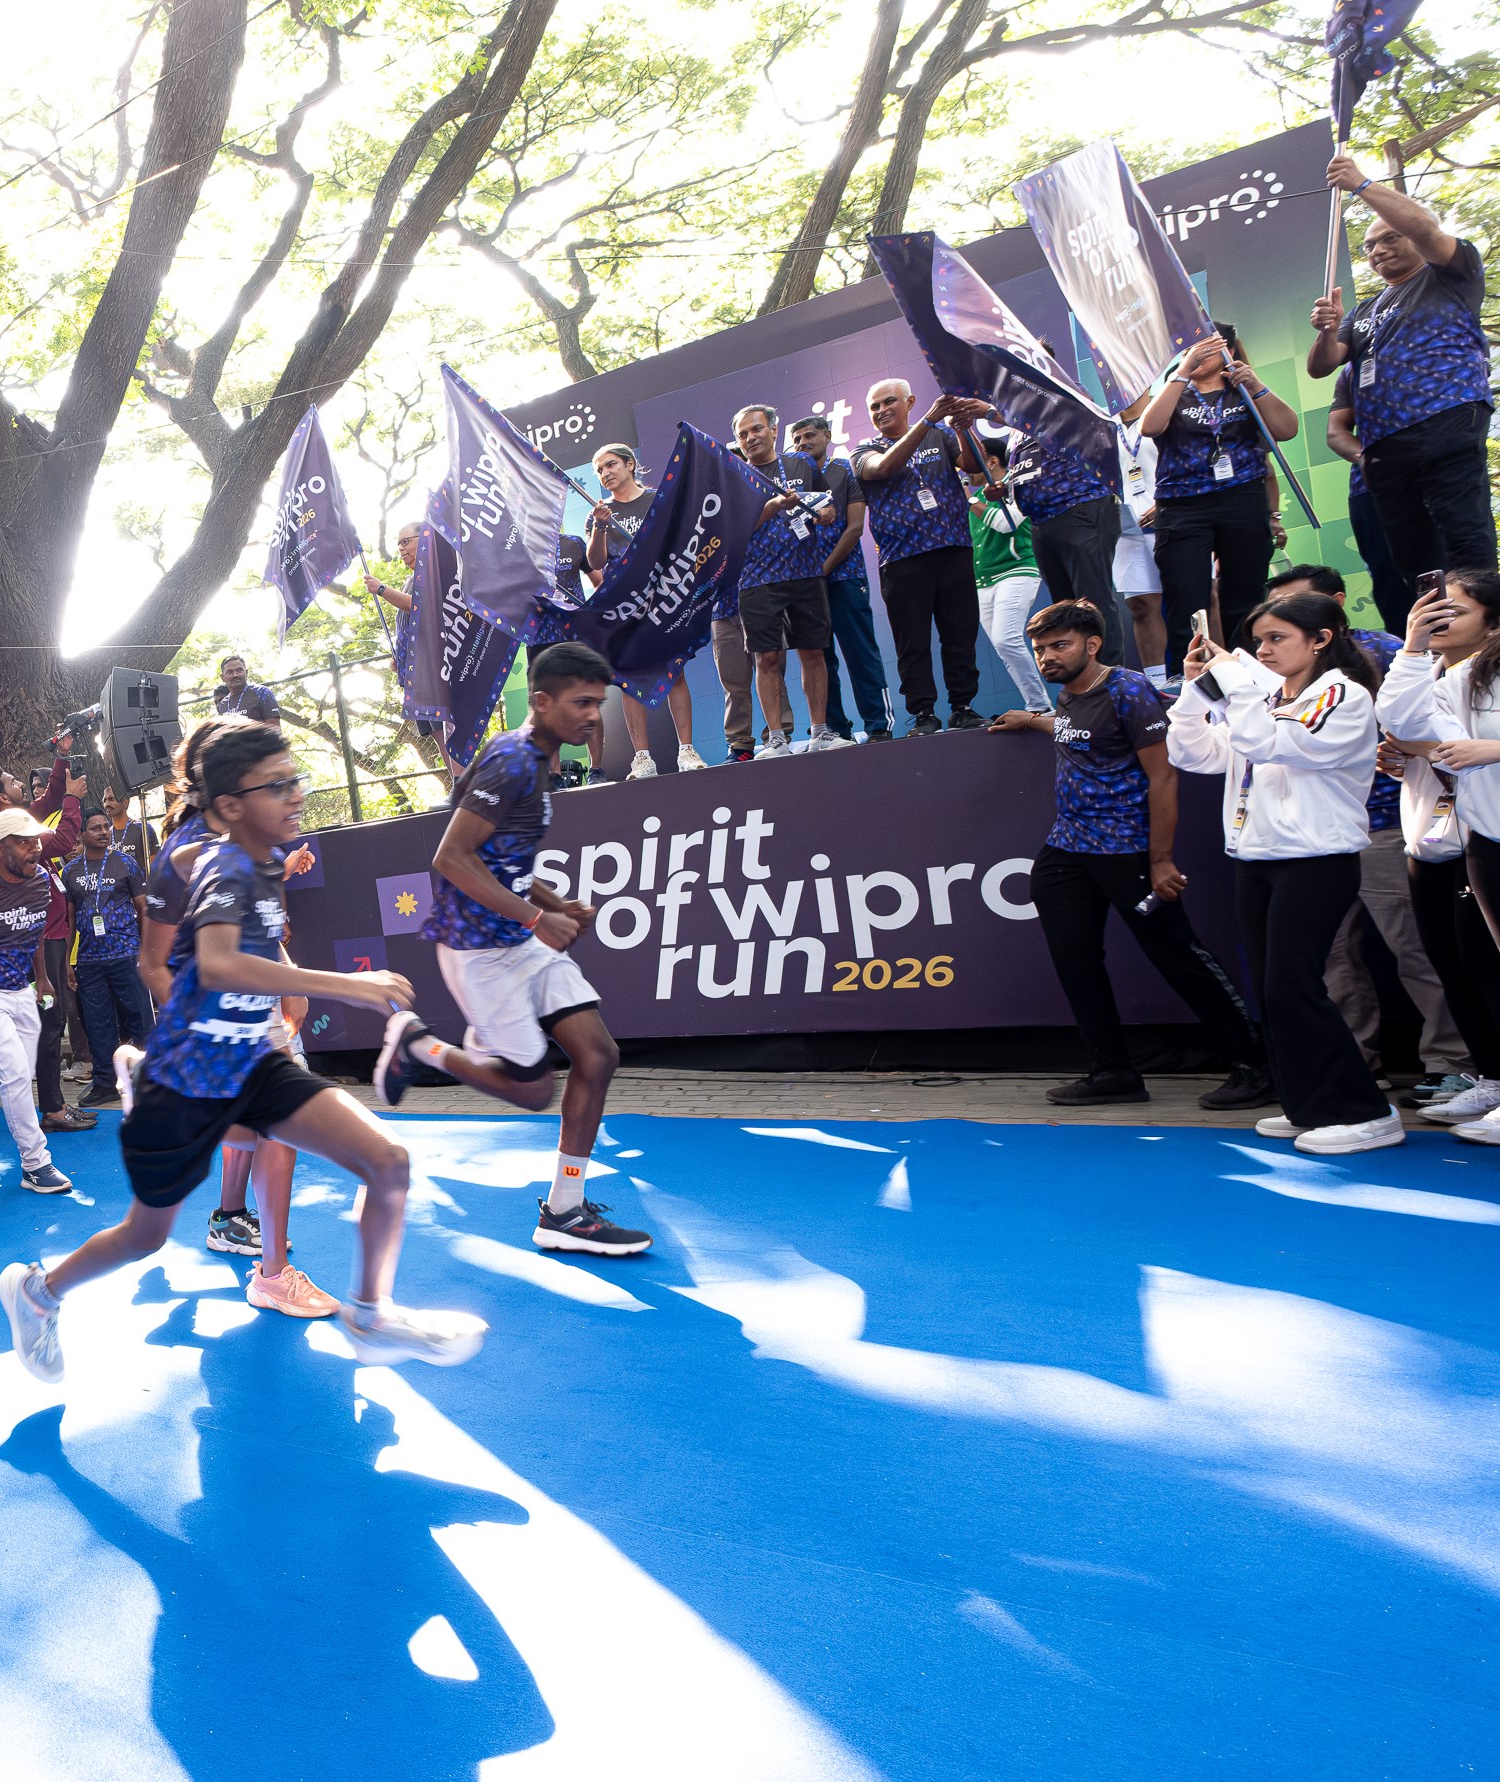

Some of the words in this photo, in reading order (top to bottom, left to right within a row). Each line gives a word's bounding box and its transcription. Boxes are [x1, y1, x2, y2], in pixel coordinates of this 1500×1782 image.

[1159, 186, 1260, 241] ipro
[524, 415, 583, 450] ipro
[291, 475, 326, 517] pro
[474, 484, 507, 539] run
[504, 527, 518, 551] wipro
[655, 493, 722, 597] wipro
[648, 571, 695, 626] run
[459, 658, 473, 682] wipro
[533, 806, 775, 909] spirit
[11, 921, 31, 931] run
[19, 910, 47, 924] wipro
[595, 870, 701, 950] of
[708, 853, 1040, 959] wipro
[656, 936, 827, 1000] run
[831, 954, 955, 992] 2026
